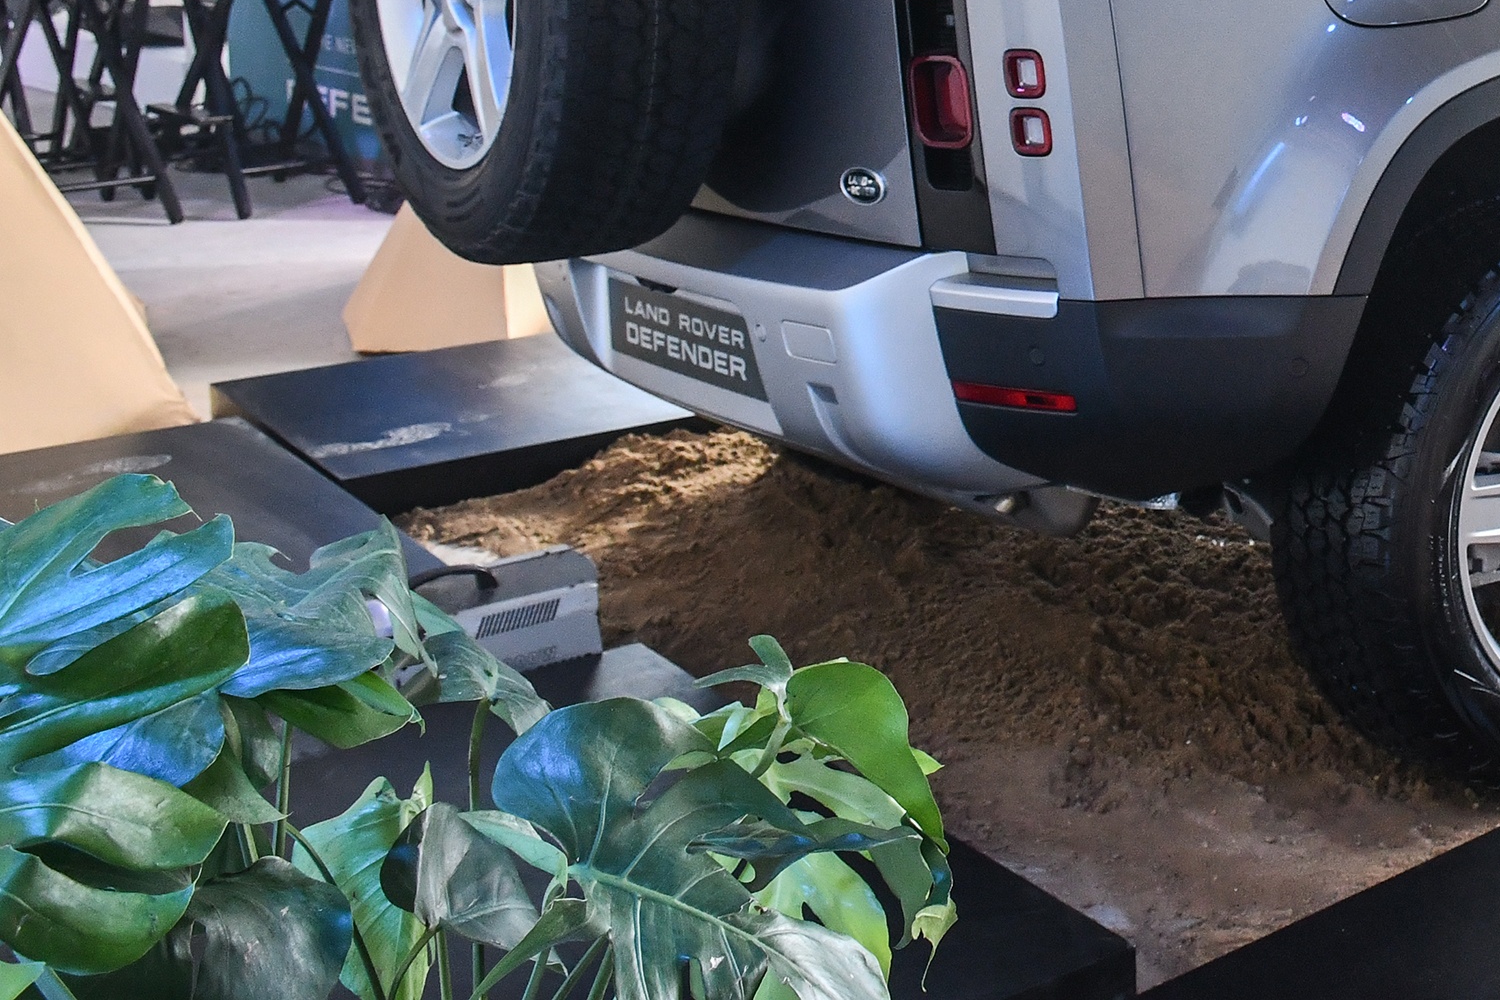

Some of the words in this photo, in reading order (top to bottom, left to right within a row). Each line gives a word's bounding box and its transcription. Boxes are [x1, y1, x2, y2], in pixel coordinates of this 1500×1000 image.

[624, 296, 670, 326] LAND
[678, 313, 745, 349] ROVER
[625, 321, 747, 381] DEFENDER
